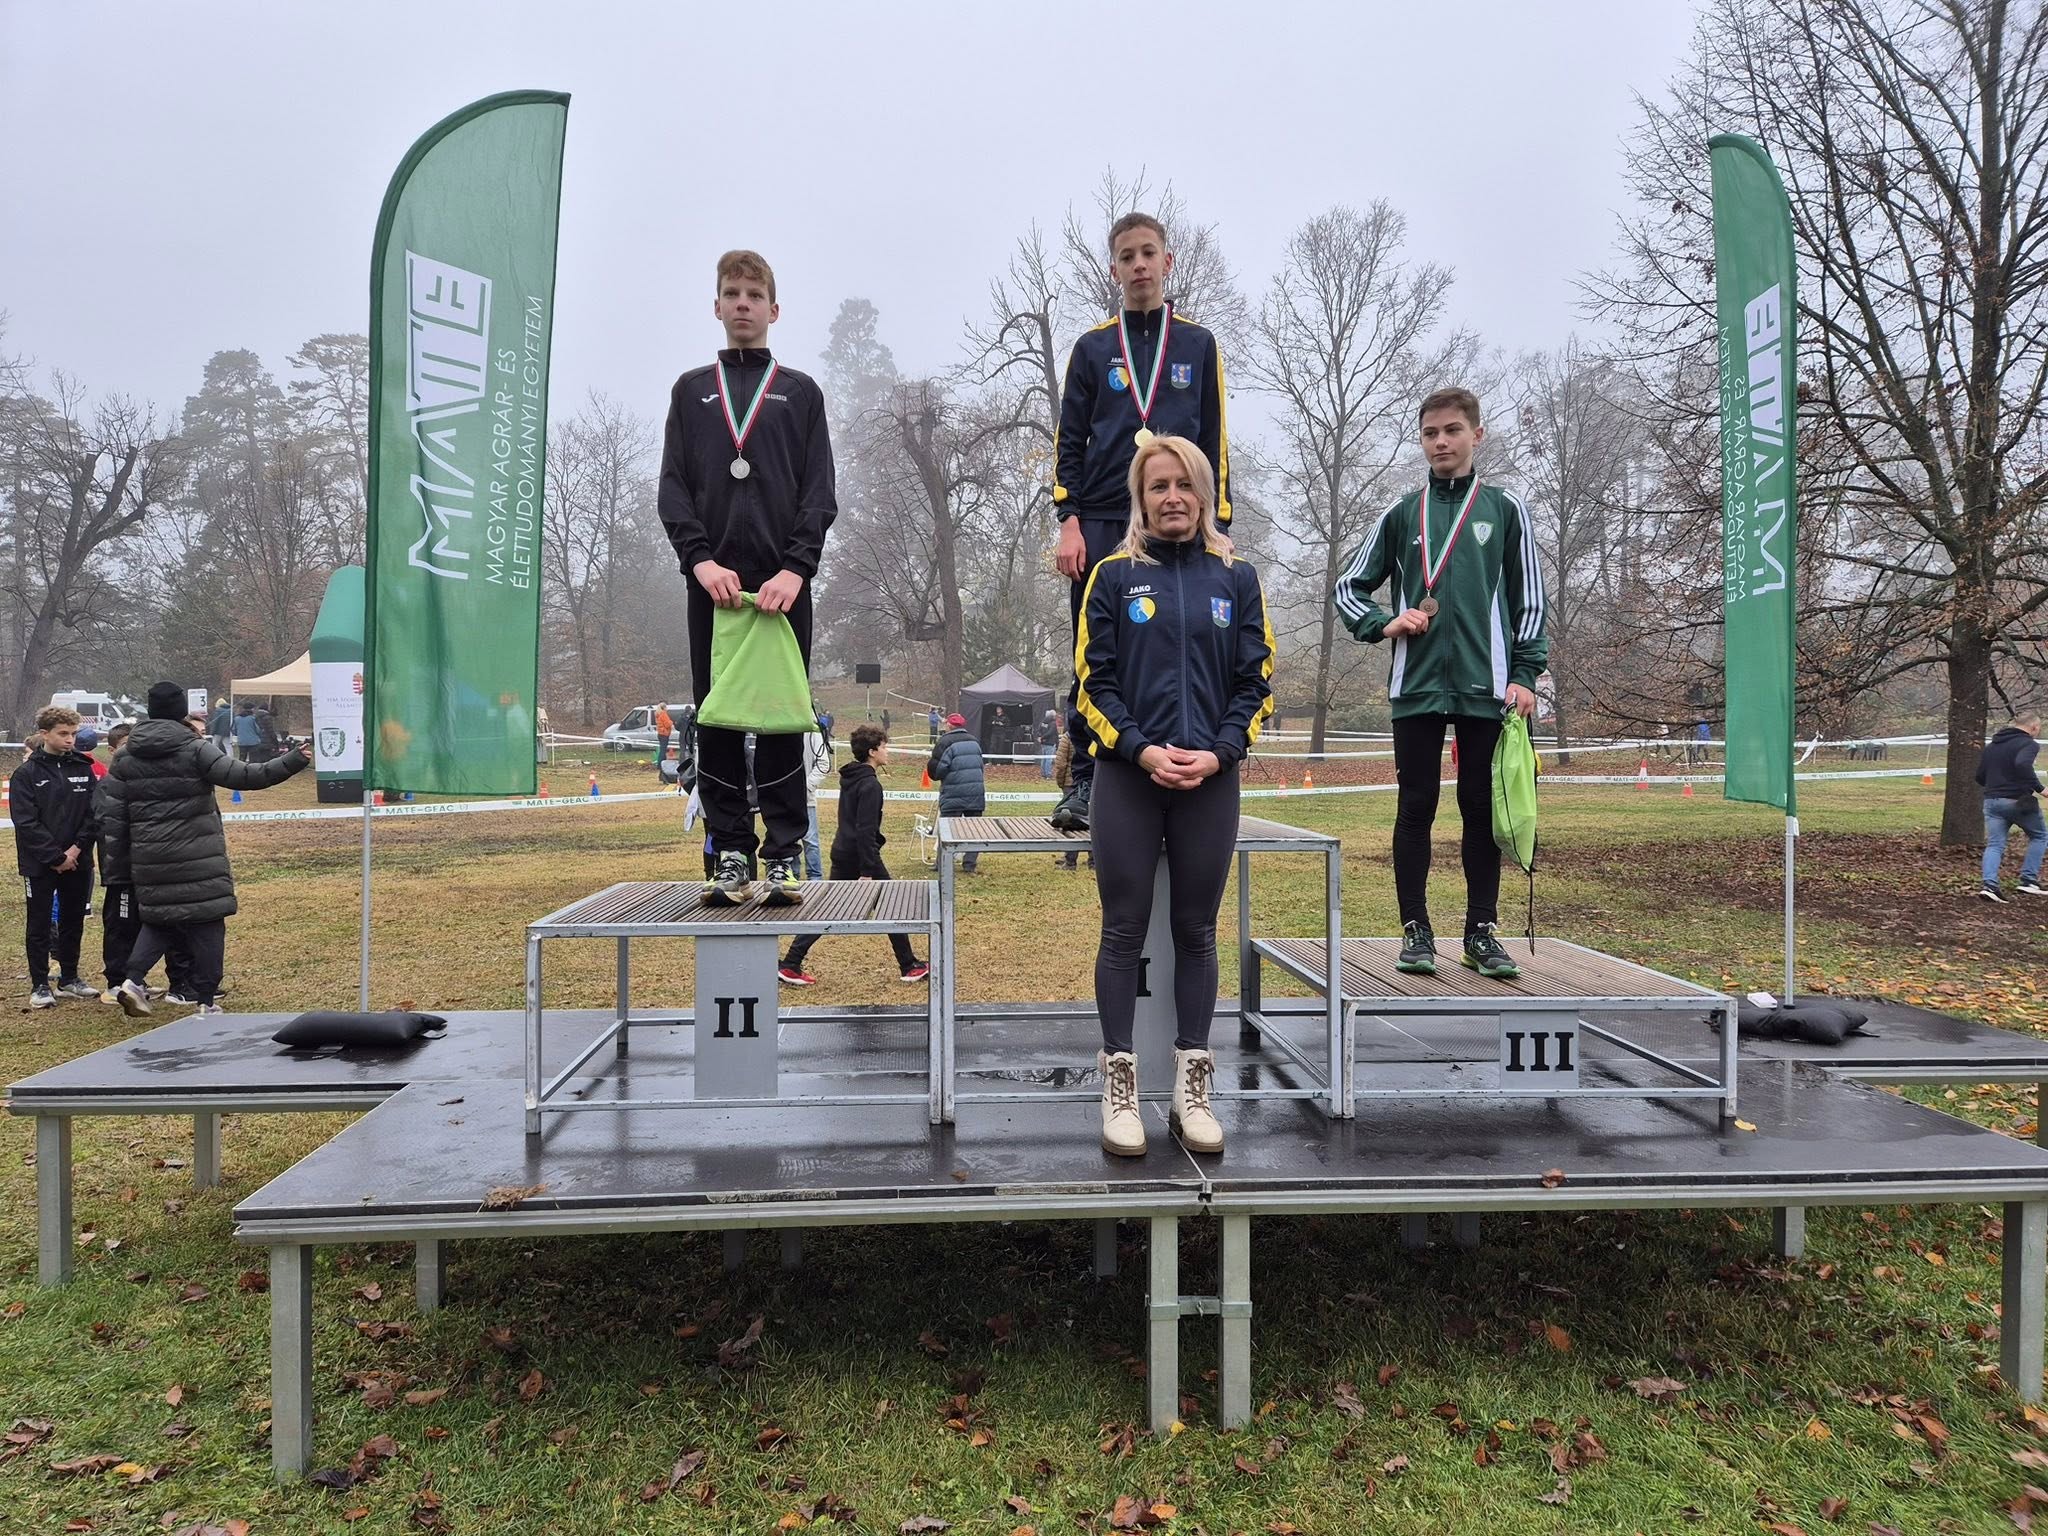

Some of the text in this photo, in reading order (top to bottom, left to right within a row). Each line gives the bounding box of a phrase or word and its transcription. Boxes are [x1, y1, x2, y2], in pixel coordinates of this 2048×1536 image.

[509, 295, 544, 589] ÉLETTUDOMÁNYI EGYETEM
[485, 348, 517, 584] MAGYAR AGRÁR- ÉS
[1129, 584, 1152, 595] JAKO
[200, 696, 206, 707] 3
[385, 805, 455, 815] MATE-GEAC
[526, 797, 590, 807] MATE-GEAC
[713, 997, 760, 1038] II
[1505, 1032, 1574, 1072] III
